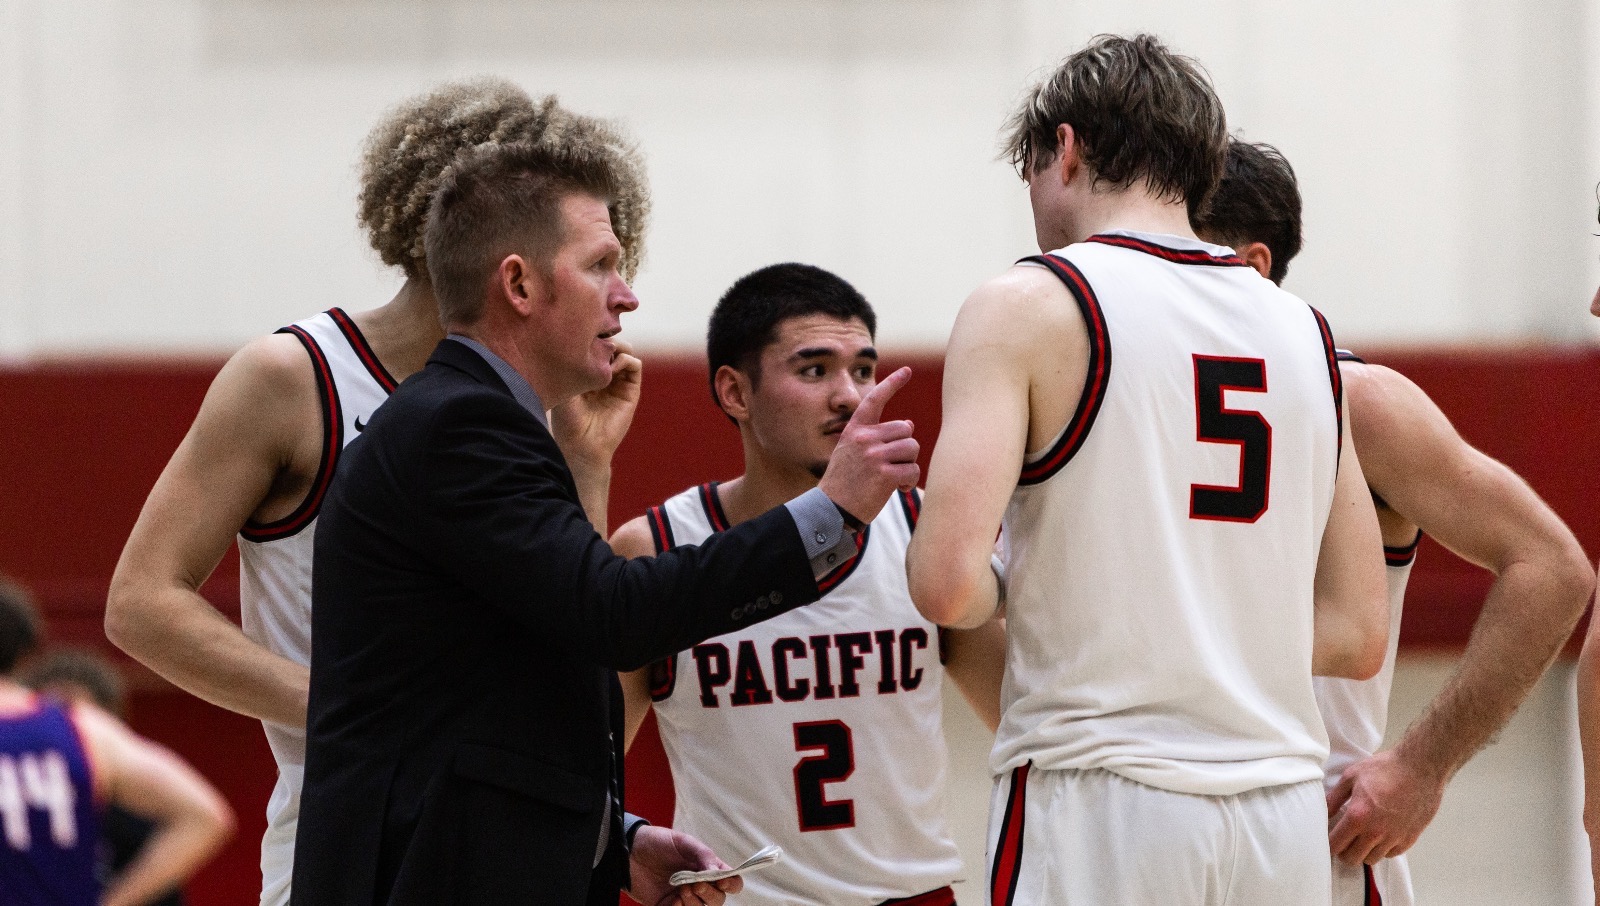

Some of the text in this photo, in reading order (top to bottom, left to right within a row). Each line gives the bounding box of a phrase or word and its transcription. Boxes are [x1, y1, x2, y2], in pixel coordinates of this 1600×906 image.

[1189, 353, 1272, 524] 5
[692, 627, 928, 708] PACIFIC
[792, 719, 855, 832] 2
